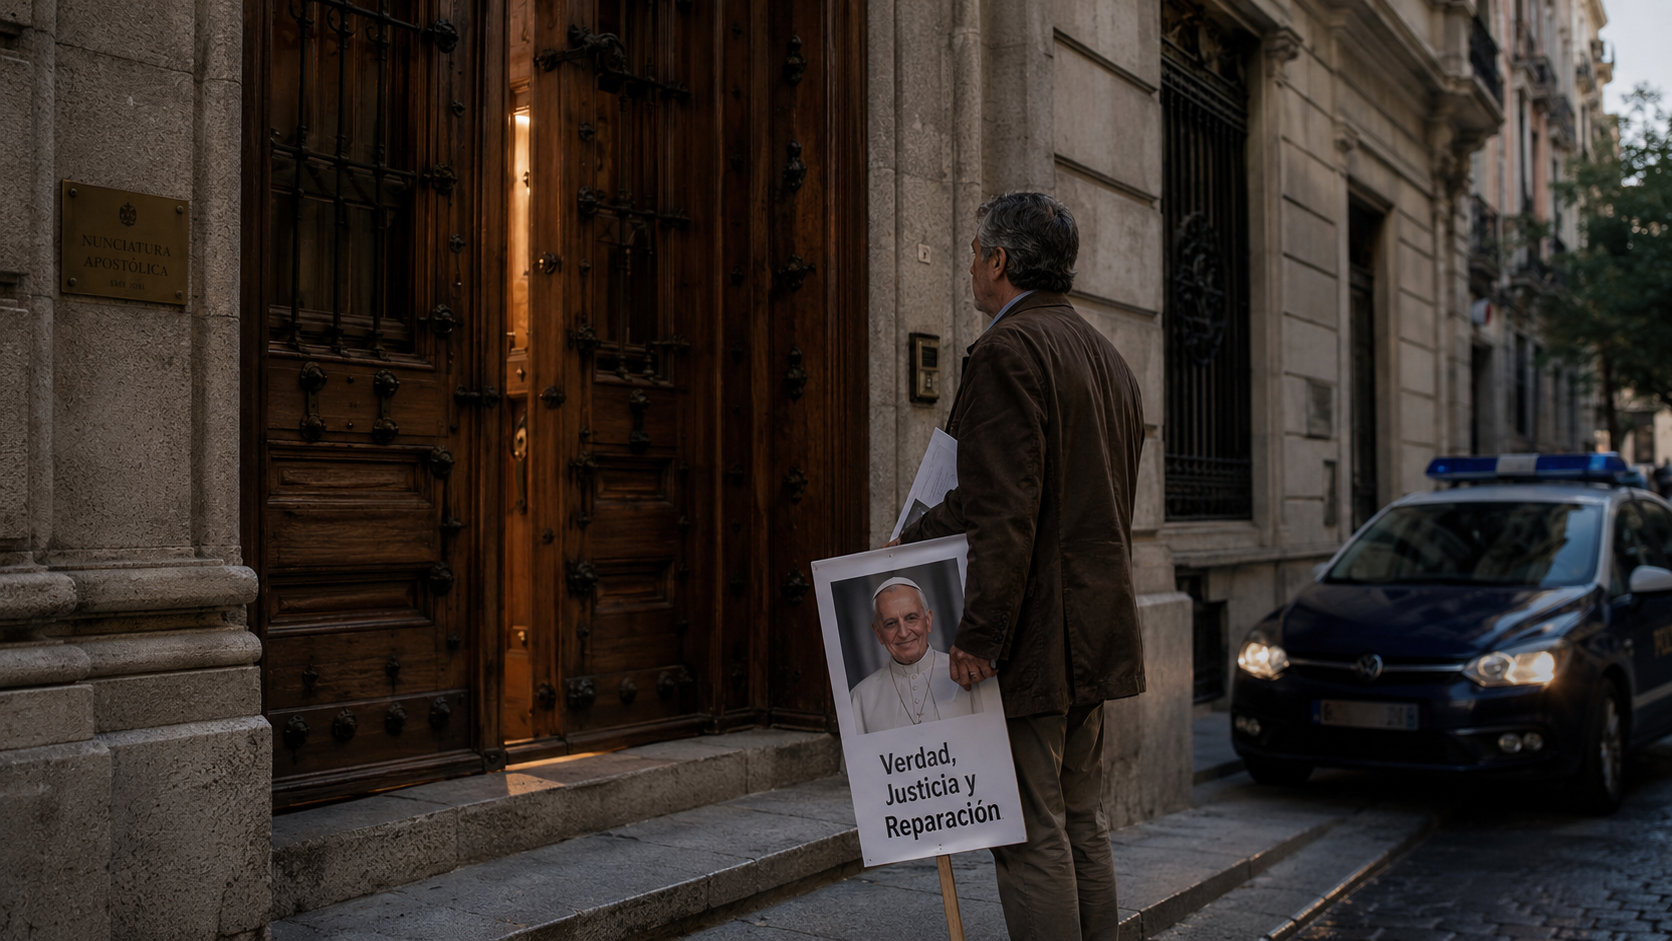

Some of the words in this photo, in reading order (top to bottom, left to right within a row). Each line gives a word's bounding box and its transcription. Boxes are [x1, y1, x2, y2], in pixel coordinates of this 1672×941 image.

[81, 234, 171, 257] NUNCIATURA
[83, 256, 169, 276] APOSTÓLICA
[879, 742, 957, 775] Verdad,
[885, 773, 961, 806] Justicia
[964, 773, 977, 797] y
[884, 799, 1002, 840] Reparación
